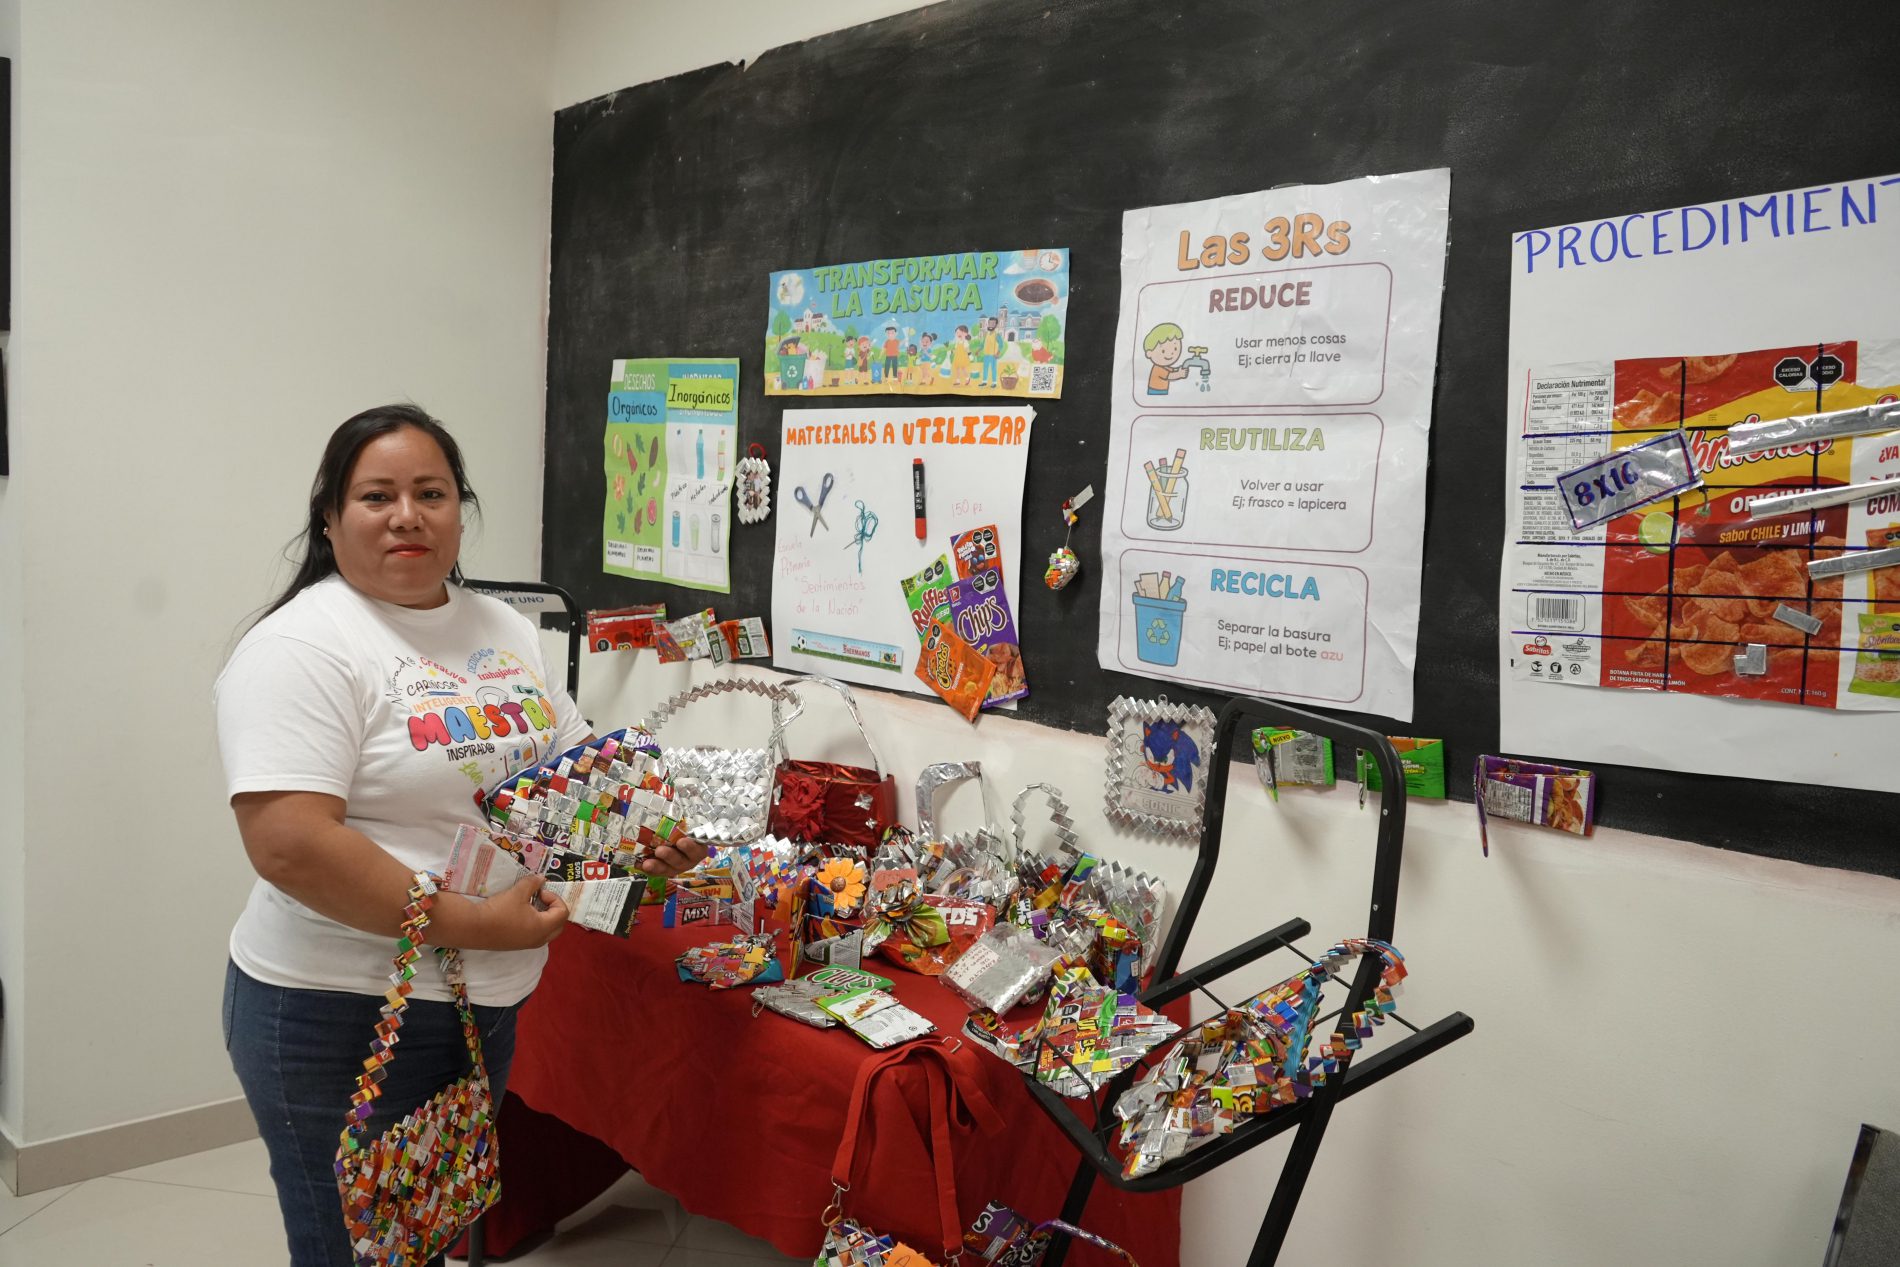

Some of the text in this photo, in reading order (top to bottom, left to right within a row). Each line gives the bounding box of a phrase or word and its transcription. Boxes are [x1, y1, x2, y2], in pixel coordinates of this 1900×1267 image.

[1177, 212, 1351, 271] Las 3Rs
[813, 252, 999, 293] TRANSFORMAR
[831, 283, 983, 319] LA BASURA
[1208, 281, 1312, 313] REDUCE
[1235, 334, 1347, 349] Usar menos cosas
[1255, 353, 1291, 365] cierra
[1294, 351, 1306, 363] la
[1309, 350, 1342, 363] llave
[623, 374, 656, 391] DESECHOS
[786, 415, 1027, 446] MATERIALES A UTILIZAR
[1199, 427, 1326, 452] REUTILIZA
[1240, 479, 1324, 492] Volver a usar
[1248, 496, 1284, 508] frasco
[1298, 497, 1347, 513] lapicera
[1719, 528, 1750, 543] sabor
[1751, 525, 1781, 541] CHILE
[1782, 526, 1789, 538] y
[1210, 568, 1320, 602] RECICLA
[519, 596, 545, 604] UNO
[911, 586, 951, 635] Ruffles
[957, 595, 1008, 646] Chip's
[1217, 619, 1331, 642] Separar la basura
[1234, 640, 1267, 655] papel
[1270, 643, 1282, 655] al
[1286, 644, 1317, 659] bote
[1320, 650, 1344, 662] azu
[1524, 644, 1551, 655] Sabritas
[935, 641, 951, 691] Cheetos
[413, 695, 476, 713] INTELIGENTE
[1272, 734, 1291, 742] NUEVO
[683, 905, 710, 921] MIX
